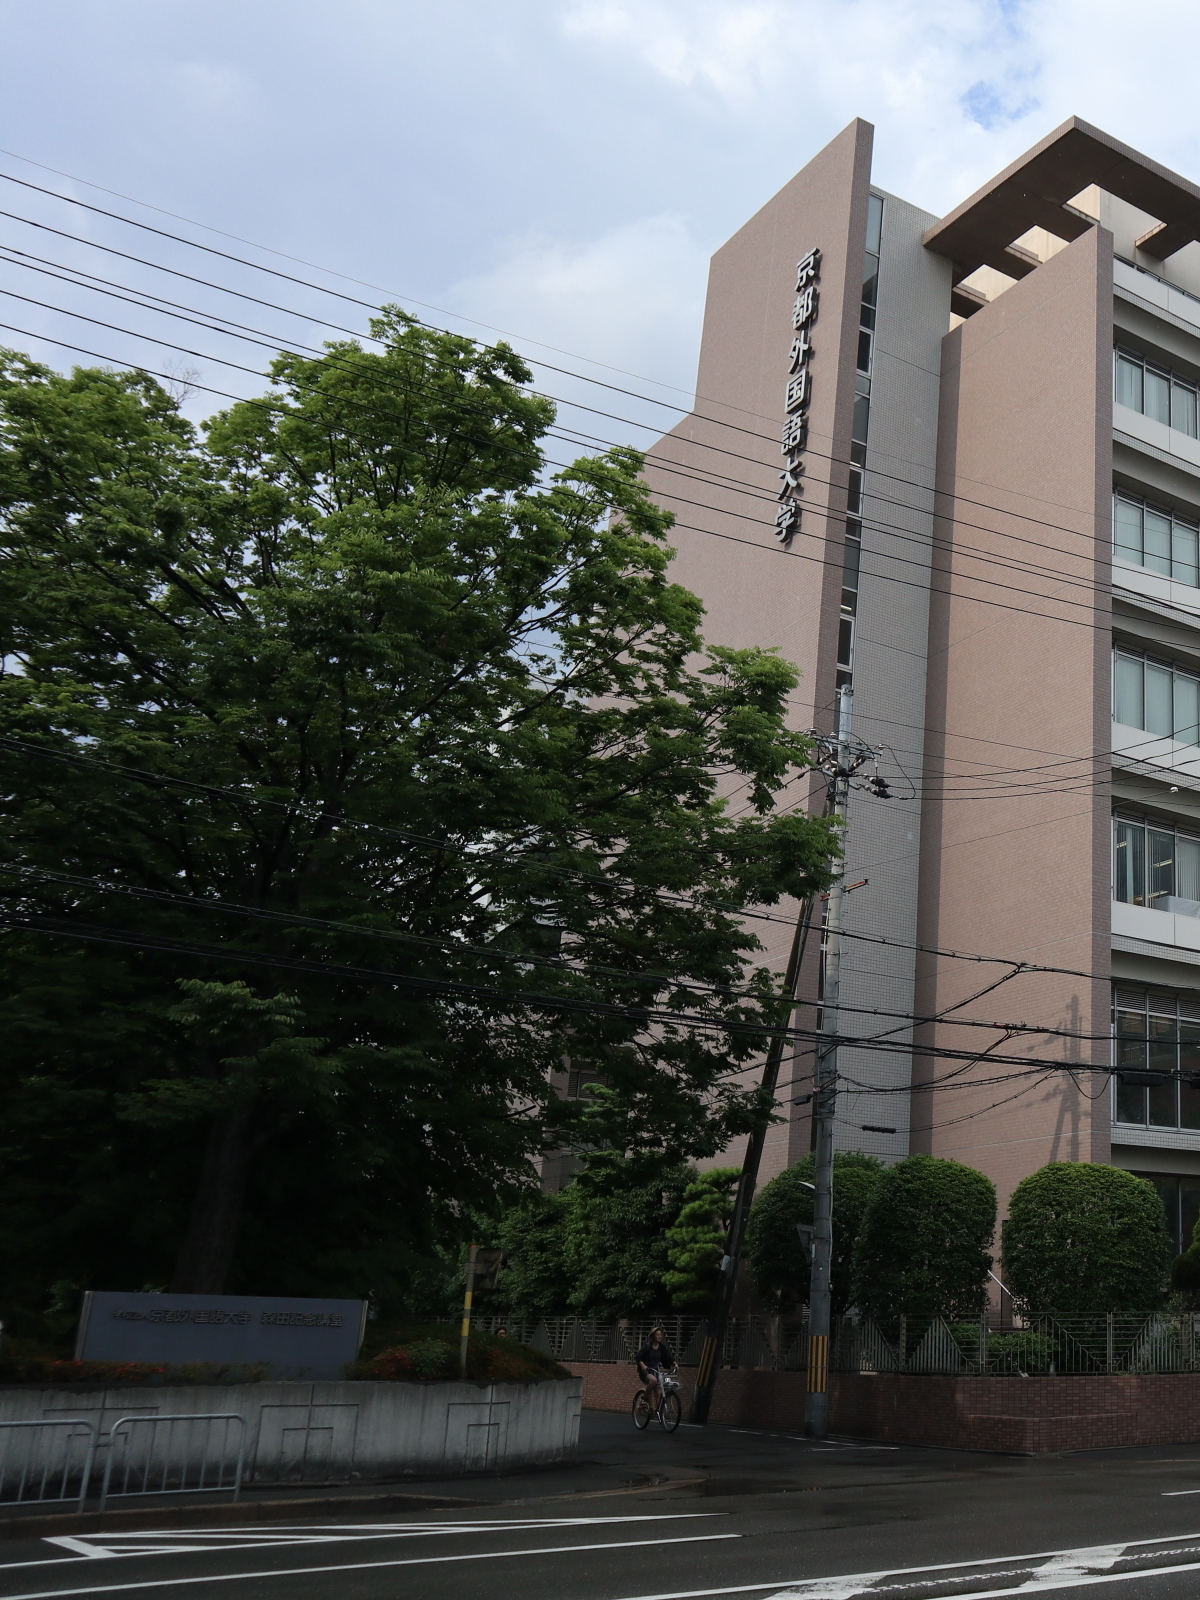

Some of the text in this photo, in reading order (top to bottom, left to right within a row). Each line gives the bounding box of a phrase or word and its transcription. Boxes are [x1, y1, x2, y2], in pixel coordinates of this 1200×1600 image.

[774, 246, 821, 543] 京都外国語大学
[150, 1308, 251, 1325] 京都外国語大学
